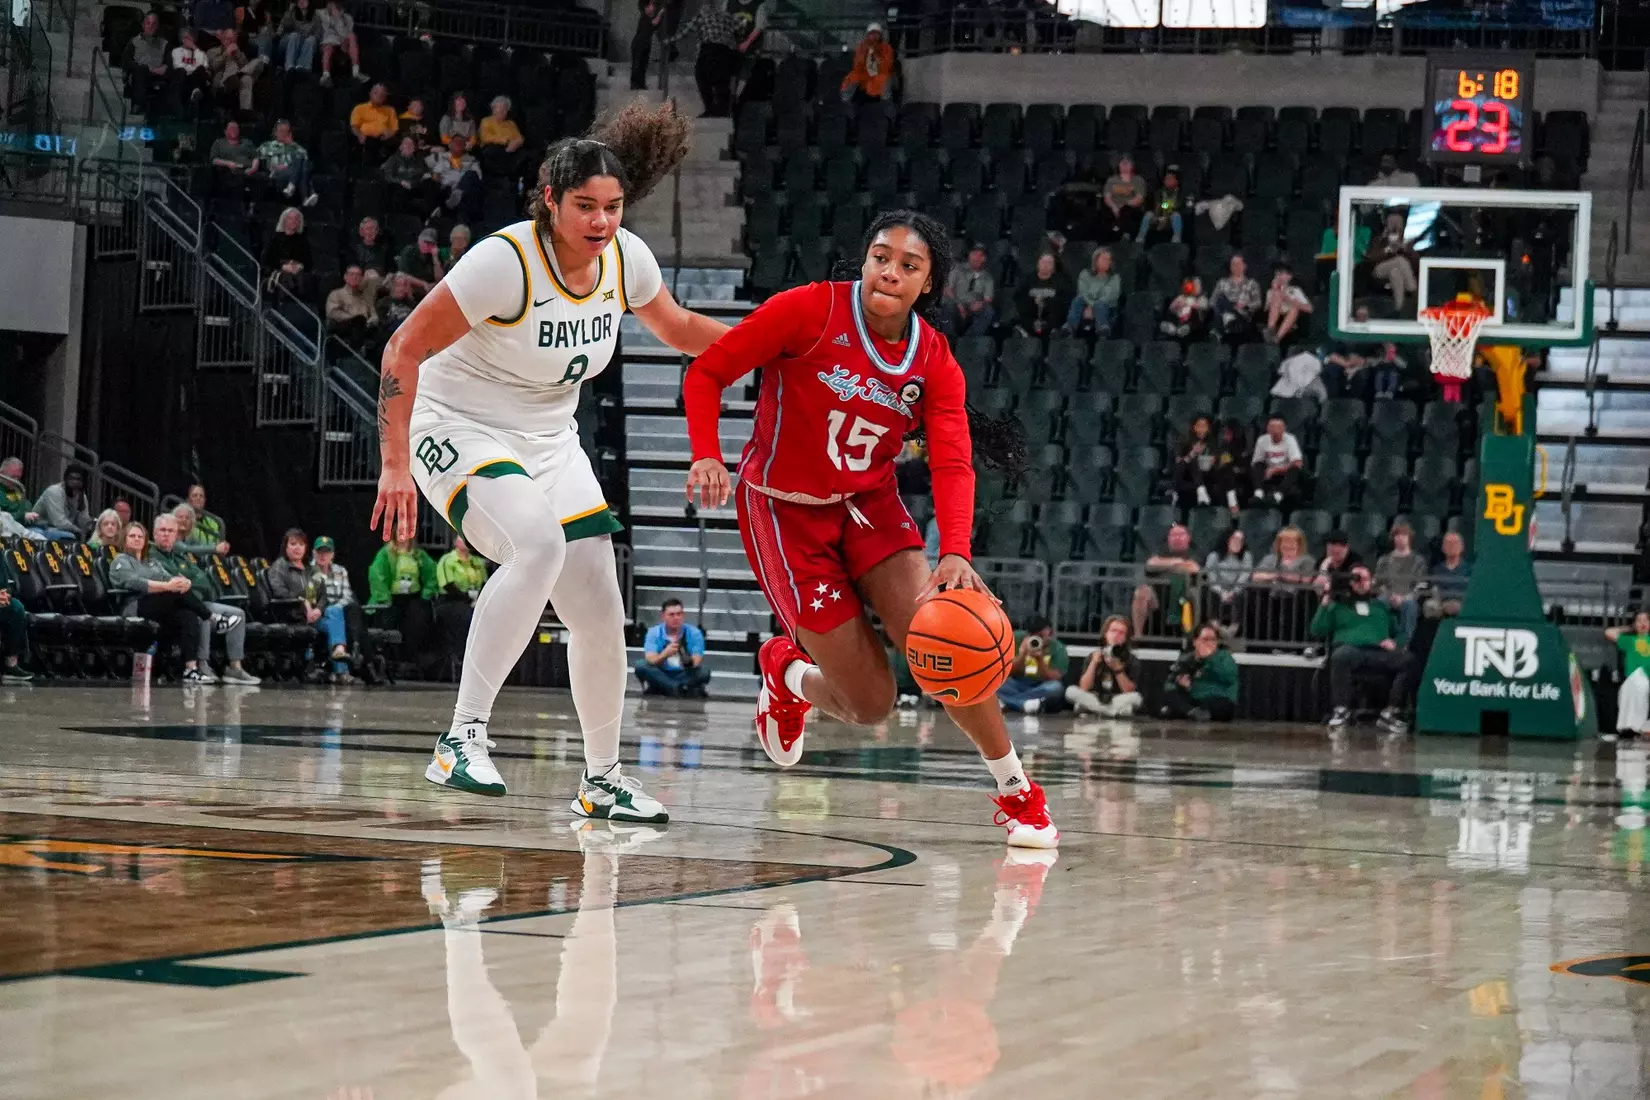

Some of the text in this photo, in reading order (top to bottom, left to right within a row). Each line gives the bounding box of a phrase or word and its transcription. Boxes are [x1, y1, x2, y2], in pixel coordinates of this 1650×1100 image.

[1458, 70, 1519, 100] 6:18
[1446, 100, 1509, 154] 23
[538, 312, 612, 348] BAYLOR
[817, 364, 861, 402] Lady
[826, 409, 890, 472] 15
[1484, 484, 1525, 535] BU
[1433, 677, 1561, 701] Your Bank for Life
